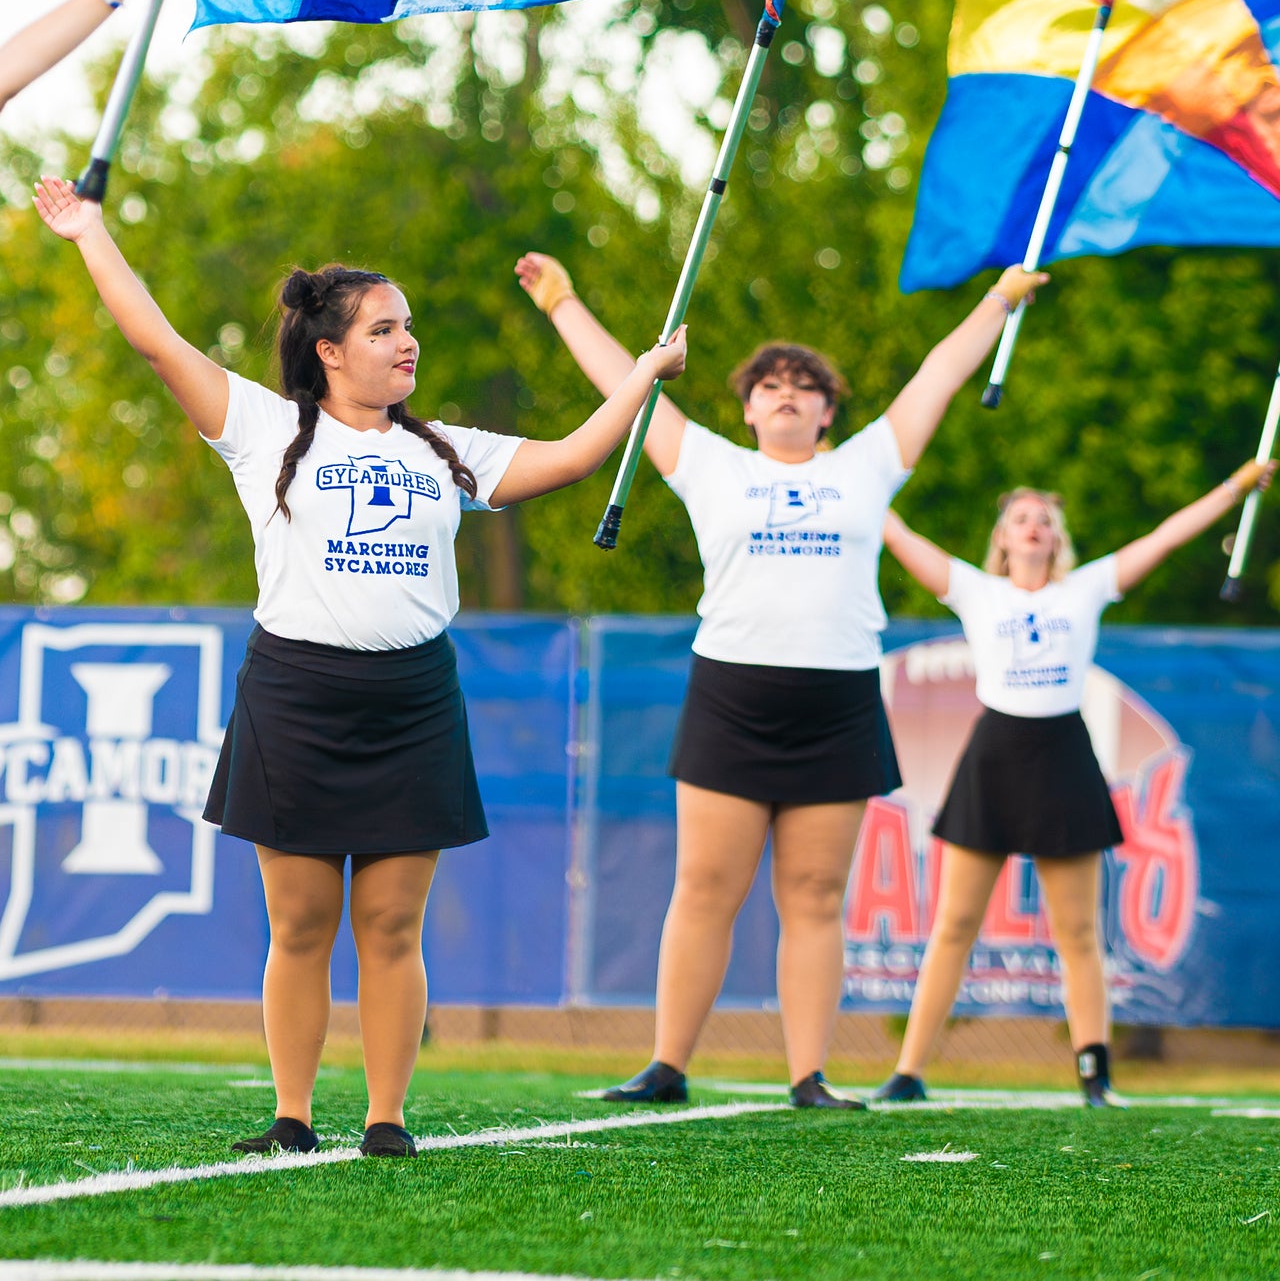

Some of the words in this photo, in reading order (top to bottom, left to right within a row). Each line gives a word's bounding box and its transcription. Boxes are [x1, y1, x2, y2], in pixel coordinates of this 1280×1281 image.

[322, 468, 437, 495] SYCAMORES
[327, 540, 429, 558] MARCHING
[324, 558, 429, 577] SYCAMORES
